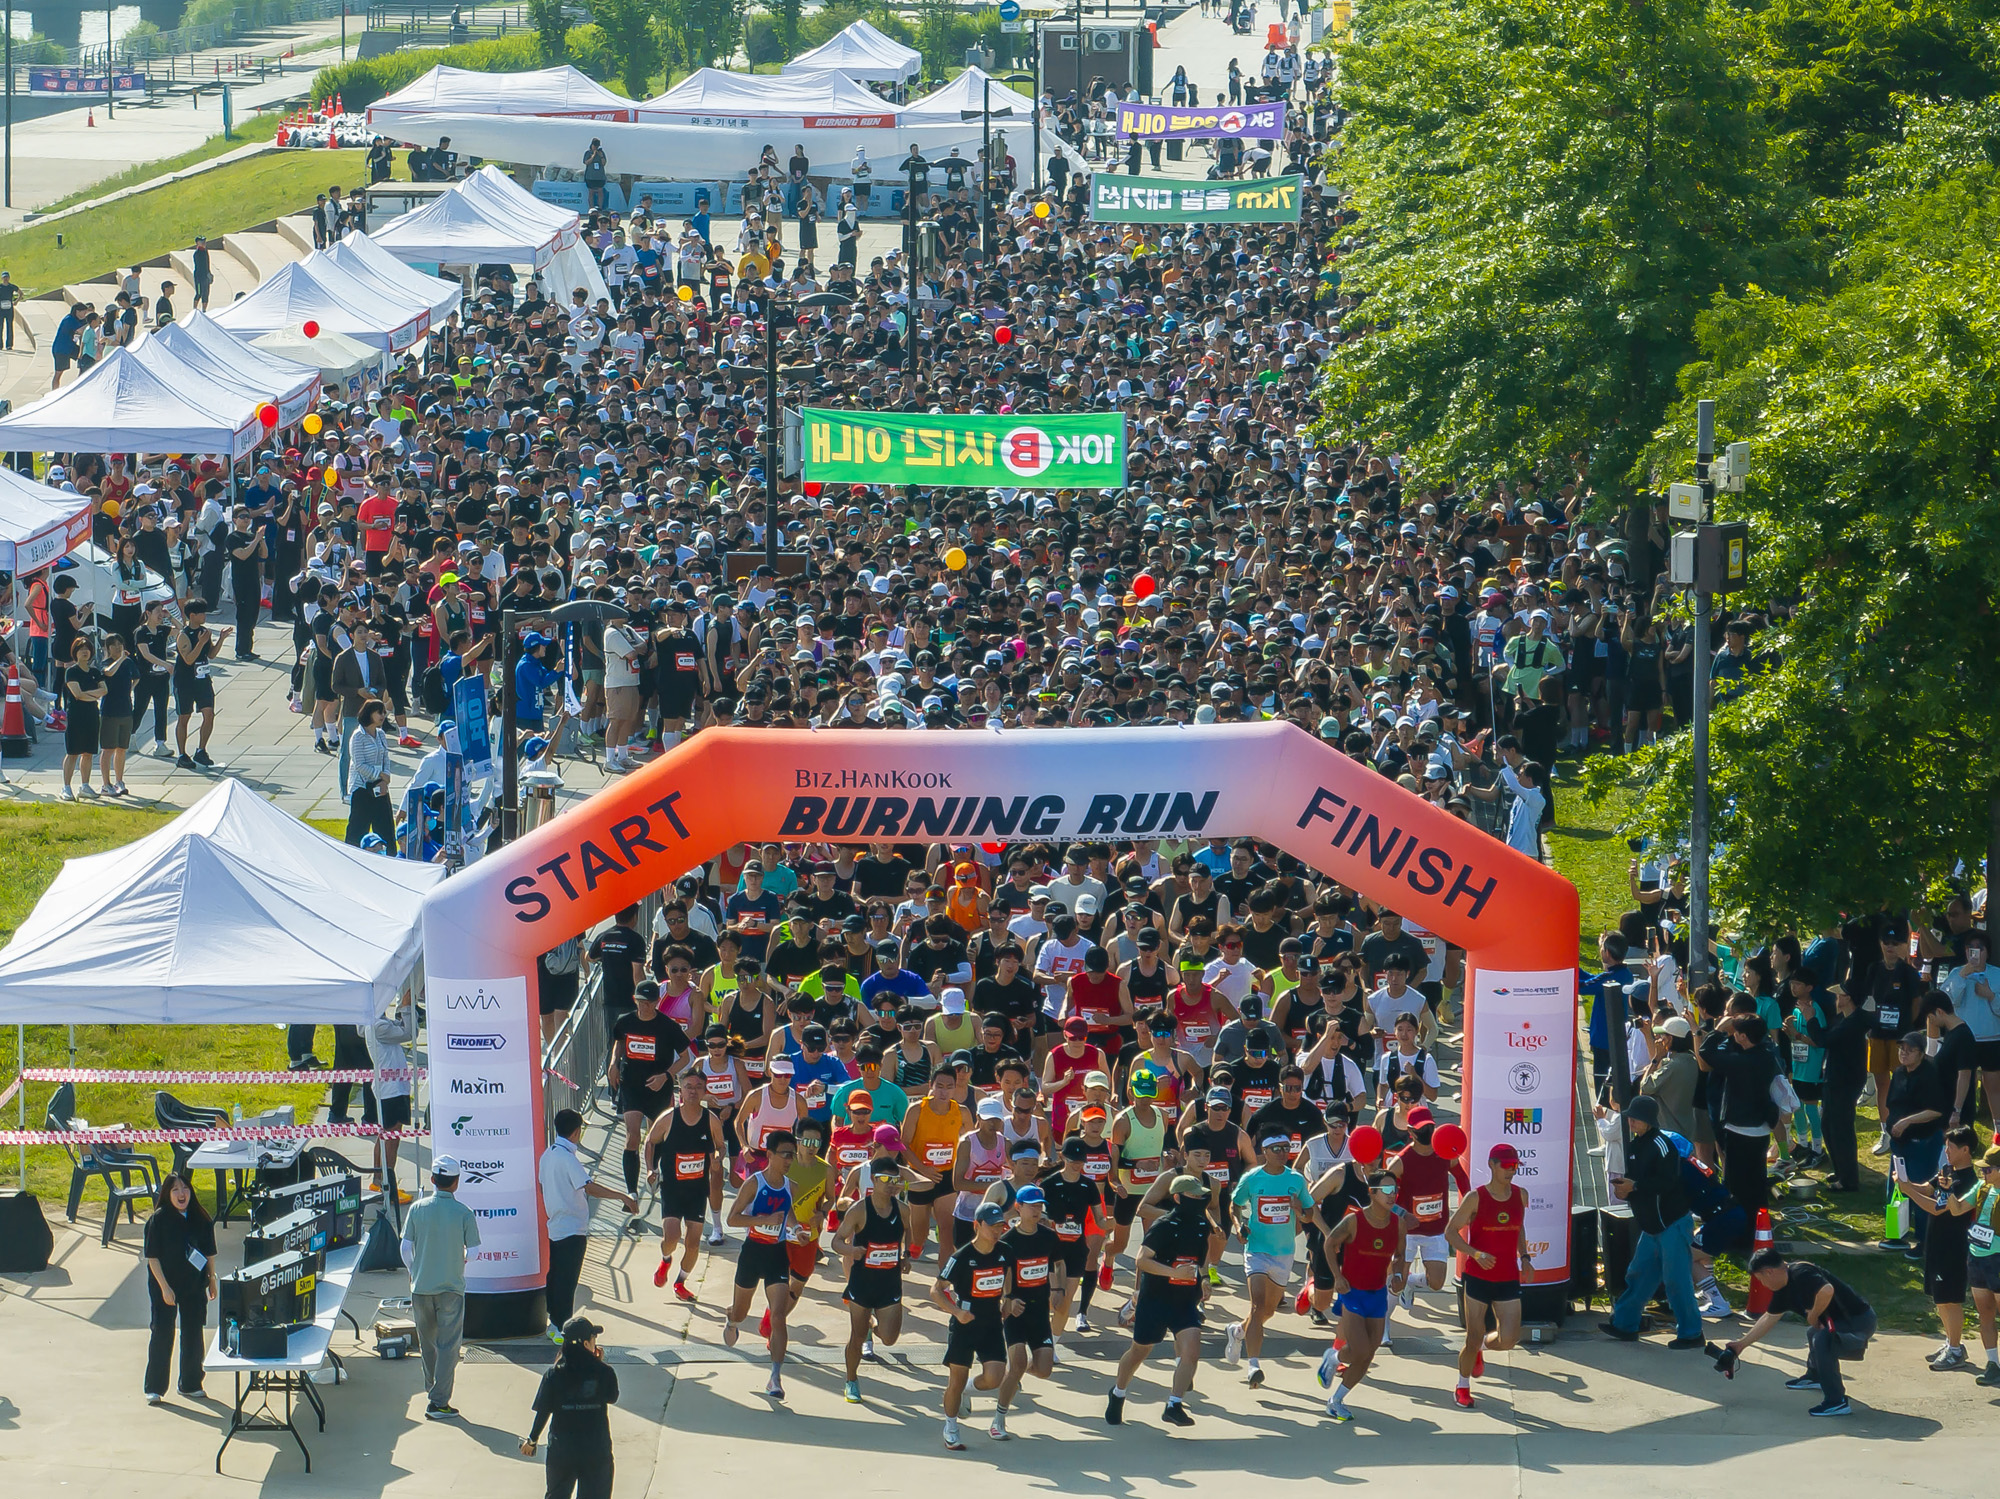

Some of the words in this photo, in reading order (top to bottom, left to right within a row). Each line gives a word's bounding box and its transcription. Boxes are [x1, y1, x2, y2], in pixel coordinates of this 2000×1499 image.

[815, 117, 857, 127] BURNING
[860, 117, 883, 126] RUN
[777, 795, 1066, 837] BURNING
[1077, 790, 1220, 835] RUN
[504, 790, 691, 923] START
[1296, 786, 1498, 920] FINISH
[451, 1038, 497, 1047] FAVONEX
[1504, 1032, 1548, 1051] Tage
[450, 1077, 504, 1094] Maxim
[465, 1128, 511, 1136] NEWTREE
[1504, 1123, 1543, 1134] KIND
[460, 1160, 505, 1170] Reebok
[304, 1184, 346, 1208] SAMIK
[290, 1221, 318, 1247] SAMIK
[269, 1263, 304, 1290] SAMIK
[299, 1277, 312, 1291] 5km
